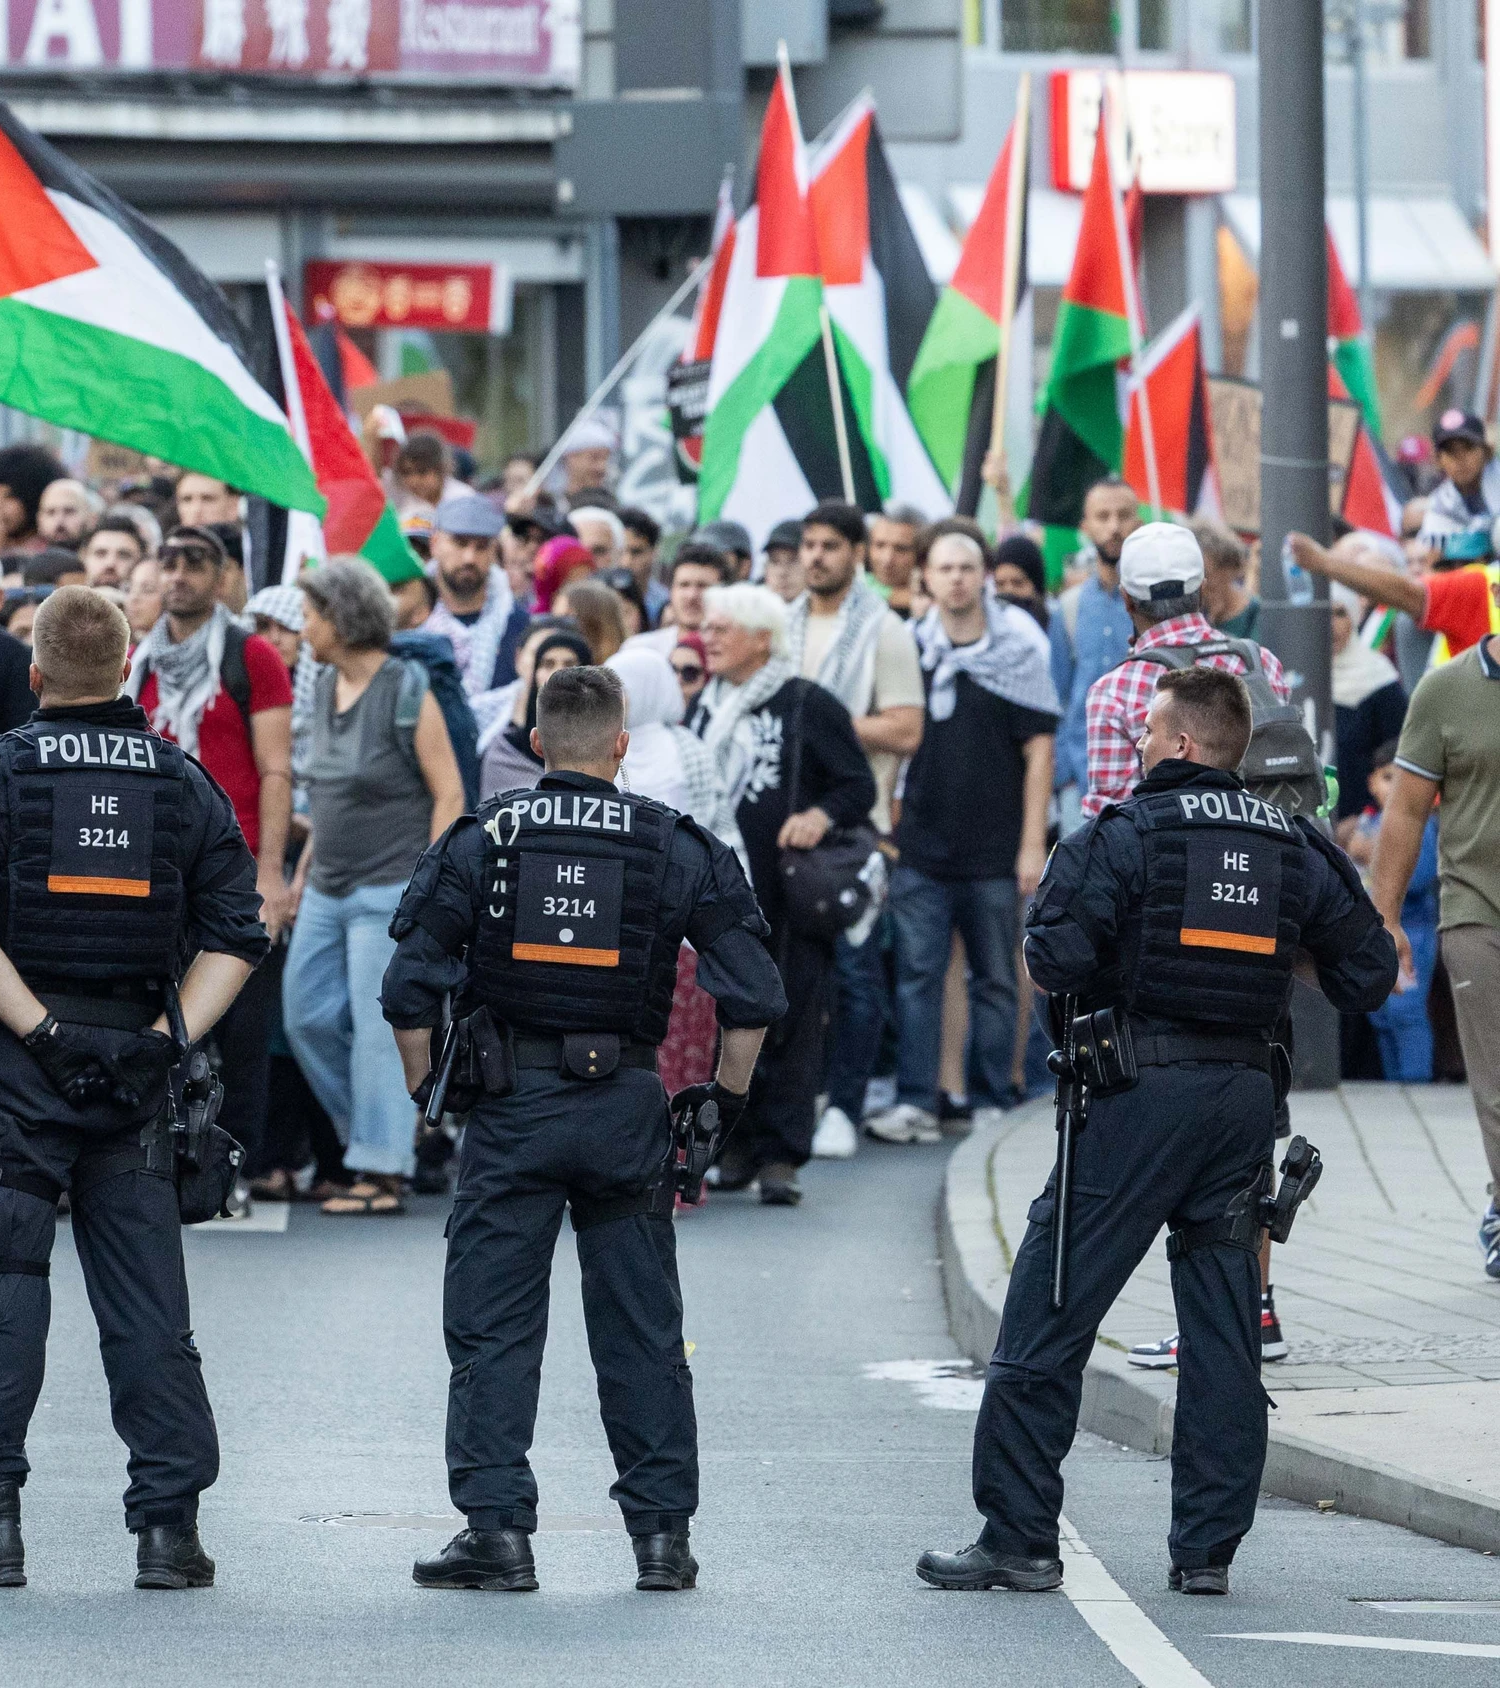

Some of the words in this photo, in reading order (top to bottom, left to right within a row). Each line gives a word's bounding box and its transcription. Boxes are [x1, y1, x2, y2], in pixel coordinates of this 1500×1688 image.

[37, 733, 156, 769] POLIZEI
[91, 794, 119, 815] HE
[511, 795, 631, 834] POLIZEI
[1179, 792, 1290, 833] POLIZEI
[78, 827, 130, 849] 3214
[1223, 850, 1250, 872] HE
[556, 864, 586, 885] HE
[1211, 882, 1259, 906] 3214
[542, 896, 596, 919] 3214
